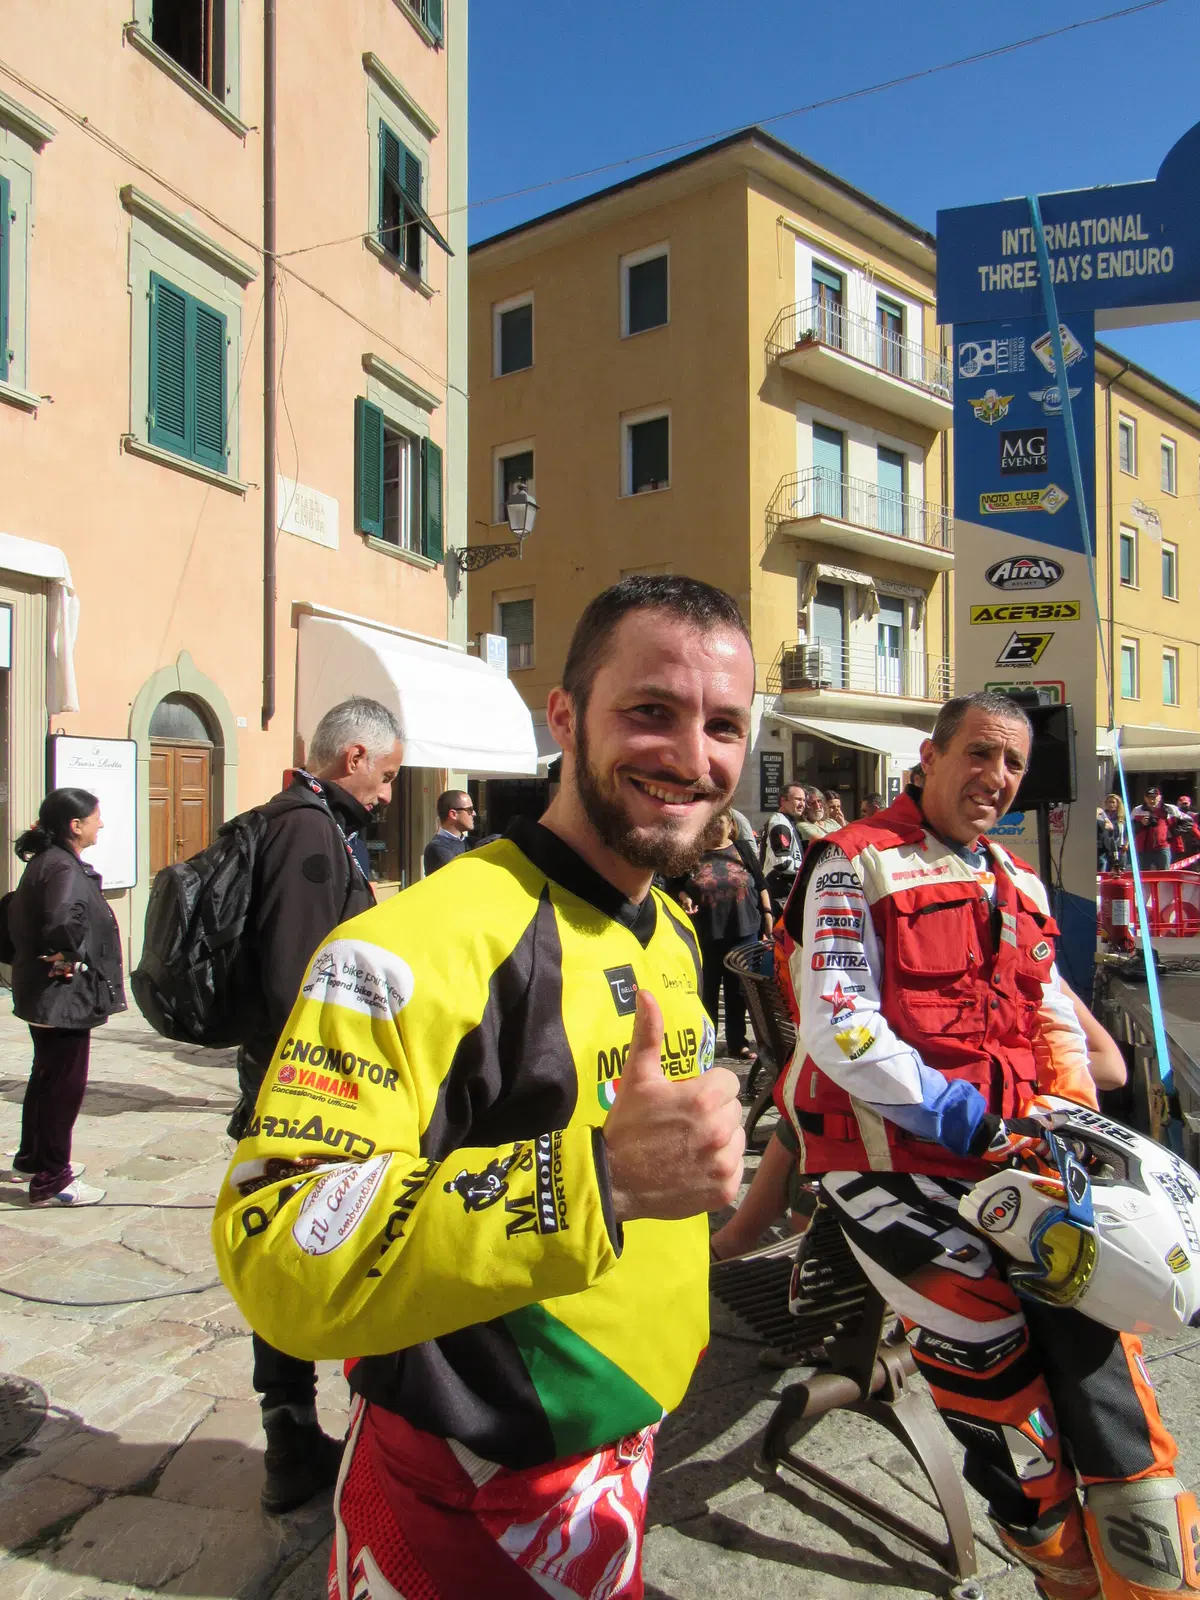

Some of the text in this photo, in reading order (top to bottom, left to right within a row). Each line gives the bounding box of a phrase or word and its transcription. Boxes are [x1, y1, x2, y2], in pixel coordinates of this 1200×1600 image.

[1097, 246, 1174, 279] ENDURO
[1001, 455, 1047, 468] EVENTS
[1002, 436, 1045, 458] MG
[981, 491, 1040, 504] MOTO CLUB
[990, 560, 1058, 583] Airoh
[342, 962, 364, 978] bike
[660, 1028, 697, 1062] LUB
[271, 1085, 358, 1111] Concessionario Ufficiale
[297, 1068, 359, 1101] YAMAHA
[537, 1133, 556, 1227] moto
[505, 1190, 540, 1240] M
[982, 1192, 1020, 1228] SUOMY
